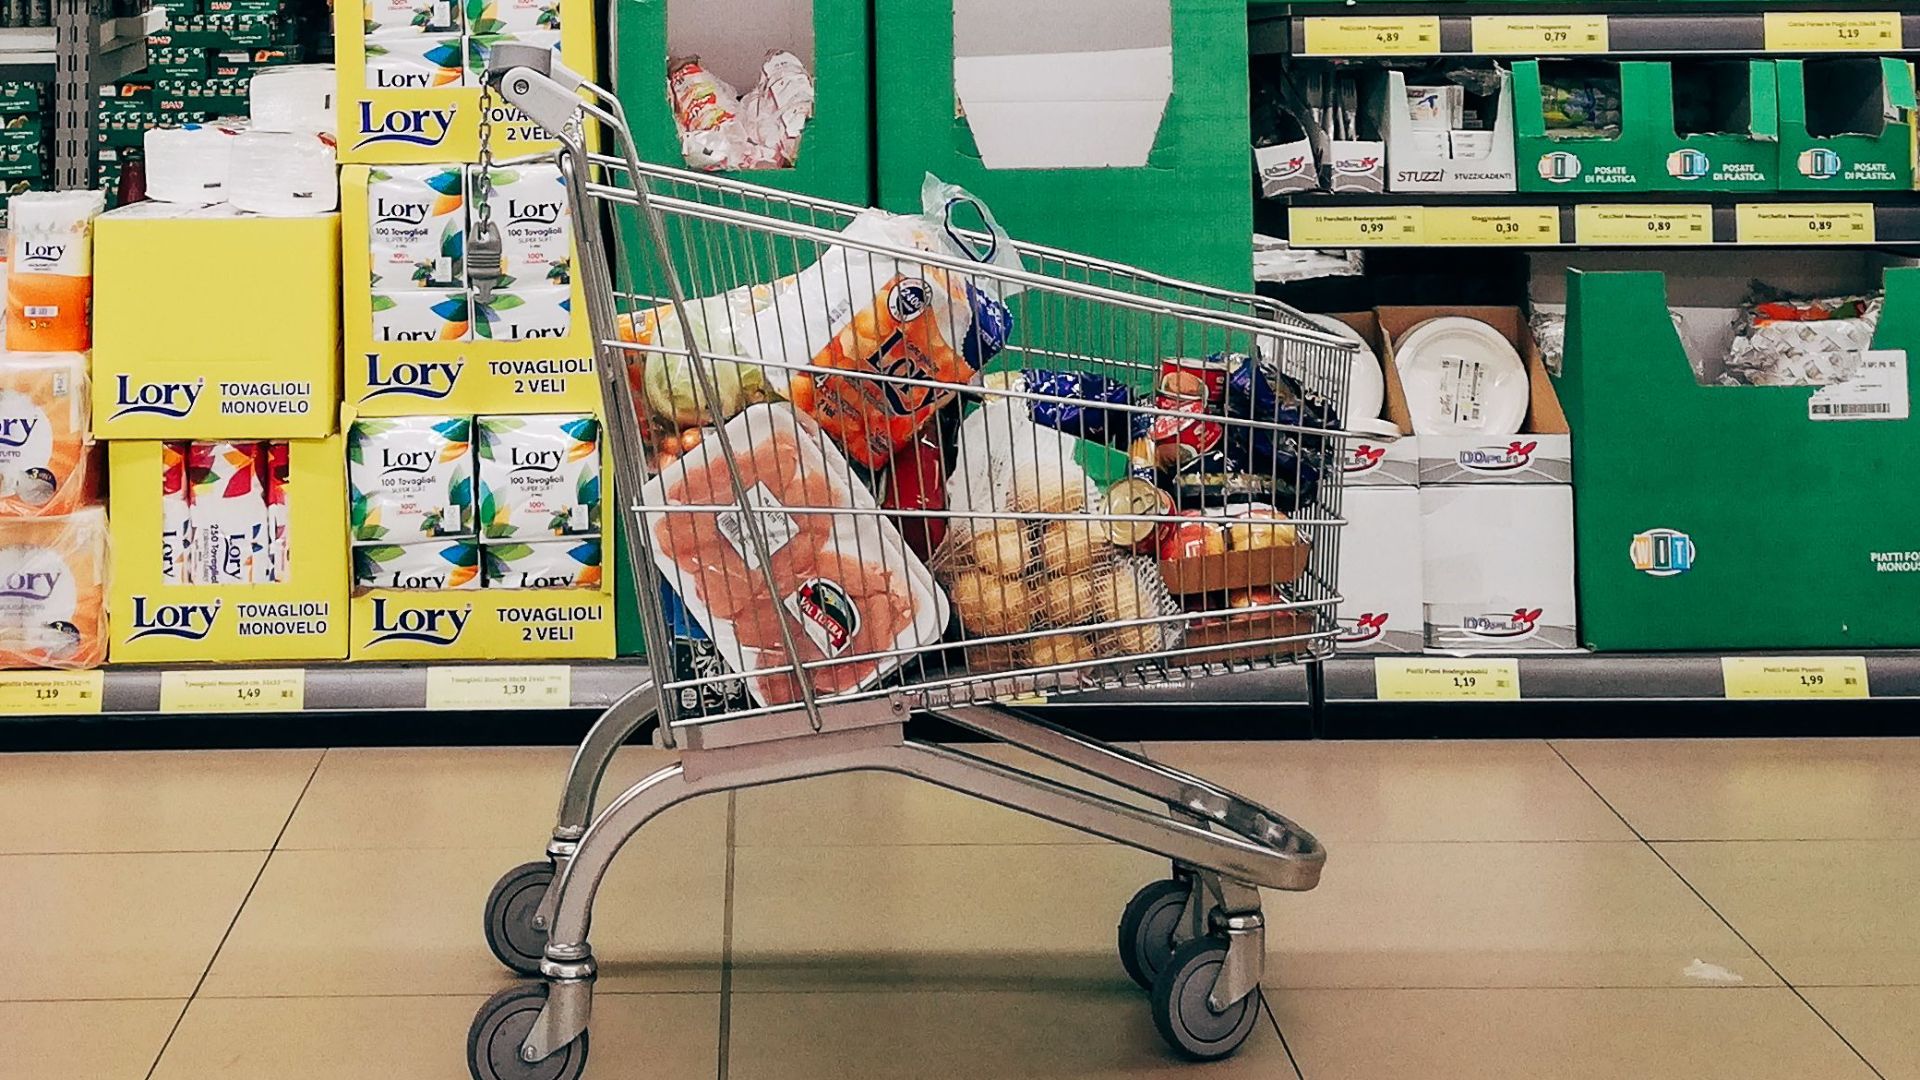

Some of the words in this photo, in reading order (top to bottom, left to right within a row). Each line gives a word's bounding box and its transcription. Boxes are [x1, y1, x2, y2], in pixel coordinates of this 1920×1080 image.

[1376, 32, 1400, 43] 4,89
[1544, 32, 1567, 42] 0,79
[1838, 29, 1860, 39] 1,19
[377, 69, 430, 87] Lory
[357, 100, 457, 148] Lory
[507, 128, 516, 140] 2
[520, 127, 556, 140] VEL
[1594, 167, 1626, 175] POSATE
[1722, 164, 1755, 172] POSATE
[1853, 163, 1886, 171] POSATE
[1454, 172, 1513, 180] STUZZICADENTI
[1585, 175, 1595, 183] DI
[1596, 175, 1637, 183] PLASTICA
[1713, 173, 1723, 181] DI
[1724, 173, 1765, 181] PLASTICA
[1844, 172, 1854, 180] DI
[1855, 172, 1896, 180] PLASTICA
[377, 198, 430, 225] Lory
[507, 199, 563, 226] Lory
[376, 228, 389, 236] 100
[1360, 223, 1384, 234] 0,99
[1496, 223, 1519, 234] 0,30
[1648, 222, 1671, 232] 0,89
[1809, 221, 1832, 232] 0,89
[508, 229, 522, 237] 100
[25, 241, 66, 262] Lory
[489, 358, 593, 375] TOVAGLIOLI
[867, 328, 953, 416] Lory
[364, 353, 465, 400] Lory
[219, 383, 311, 396] TOVAGLIOLI
[514, 381, 524, 394] 2
[528, 379, 565, 393] VELI
[114, 375, 205, 419] Lory
[221, 401, 309, 414] MONOVELO
[0, 418, 38, 446] ry
[381, 448, 437, 475] Lory
[510, 447, 565, 473] Lory
[382, 478, 396, 487] 100
[511, 476, 524, 485] 100
[223, 534, 246, 580] Lory
[1870, 552, 1903, 561] PIATTI
[1904, 551, 1920, 561] FO
[237, 603, 329, 618] TOVAGLIOLI
[497, 606, 602, 623] TOVAGLIOLI
[132, 596, 222, 641] Lory
[371, 598, 473, 647] Lory
[238, 621, 328, 636] MONOVELO
[523, 628, 532, 641] 2
[536, 627, 574, 641] VELI
[1454, 677, 1476, 688] 1,19
[1800, 675, 1824, 687] 1,99
[36, 689, 59, 700] 1,19
[238, 688, 261, 700] 1,49
[503, 685, 526, 696] 1,39
